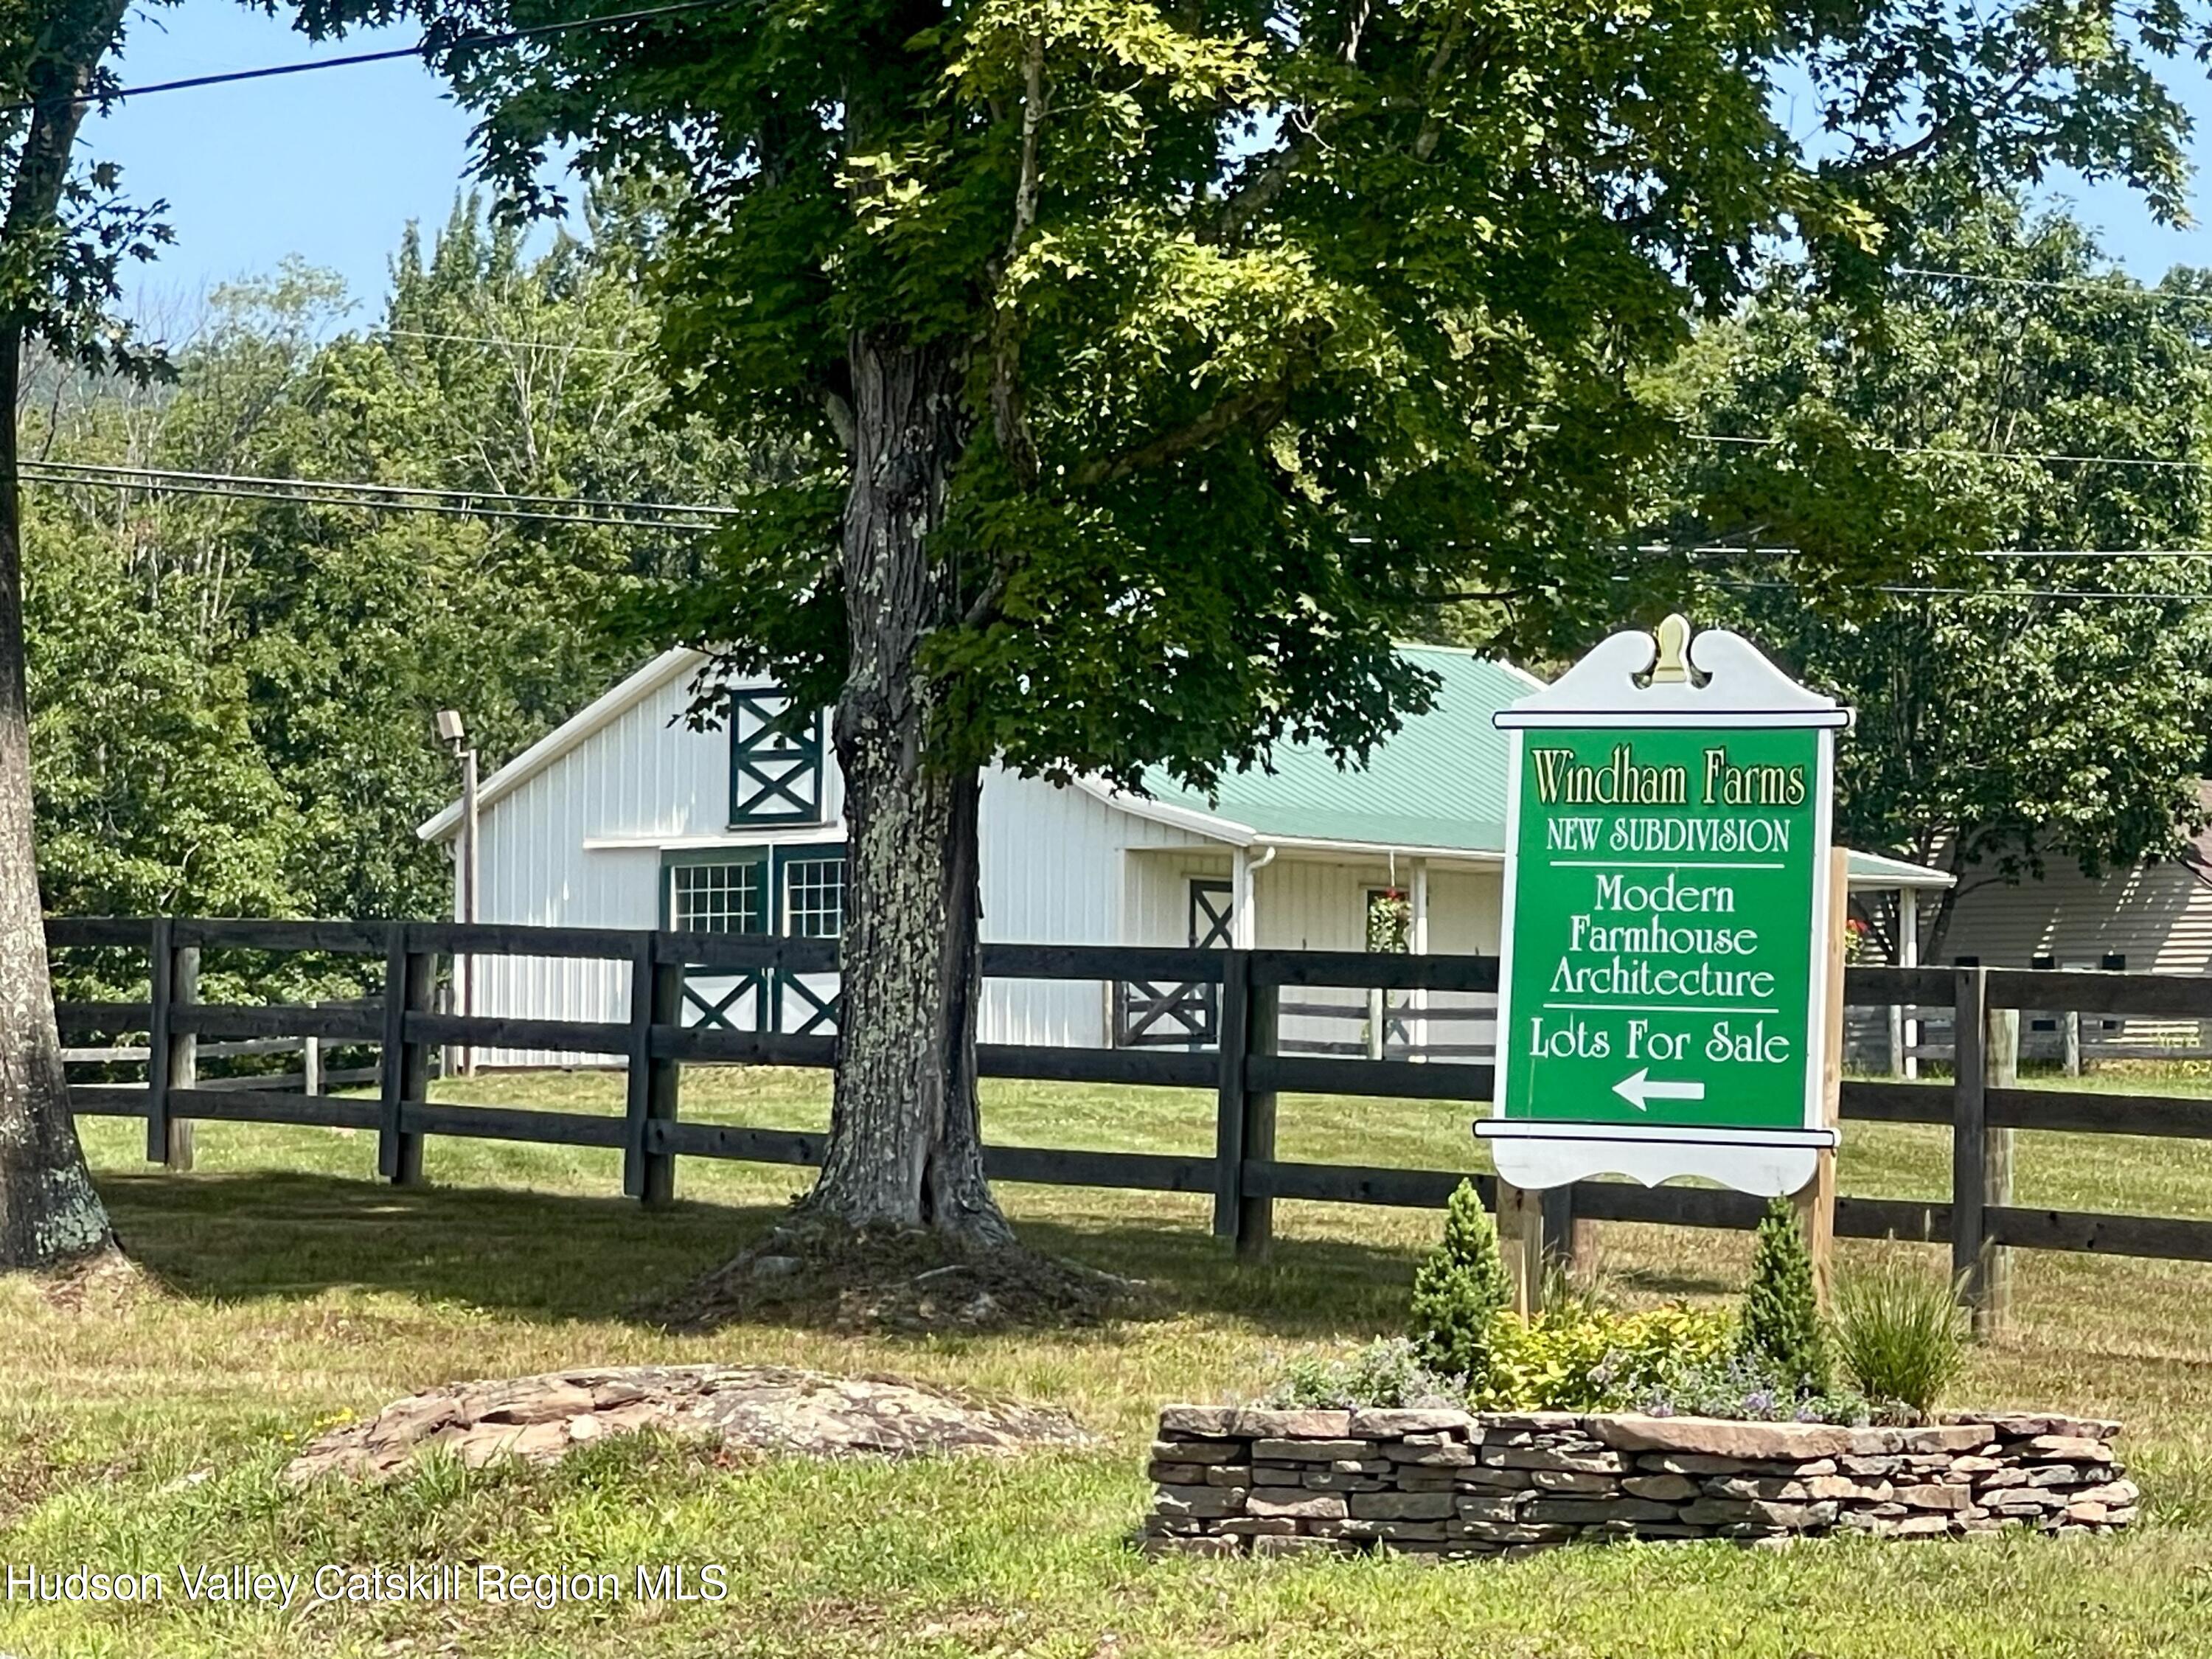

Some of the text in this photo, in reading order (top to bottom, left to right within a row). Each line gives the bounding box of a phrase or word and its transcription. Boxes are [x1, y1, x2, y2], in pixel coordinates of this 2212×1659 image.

[1531, 745, 1806, 805] Windham Farms
[1546, 817, 1791, 852] NEW SUBDIVISION
[1594, 873, 1735, 912] Modern
[1569, 914, 1758, 955] Farmhouse
[1549, 955, 1775, 998] Architecture
[1529, 1018, 1790, 1063] Lots For Sale
